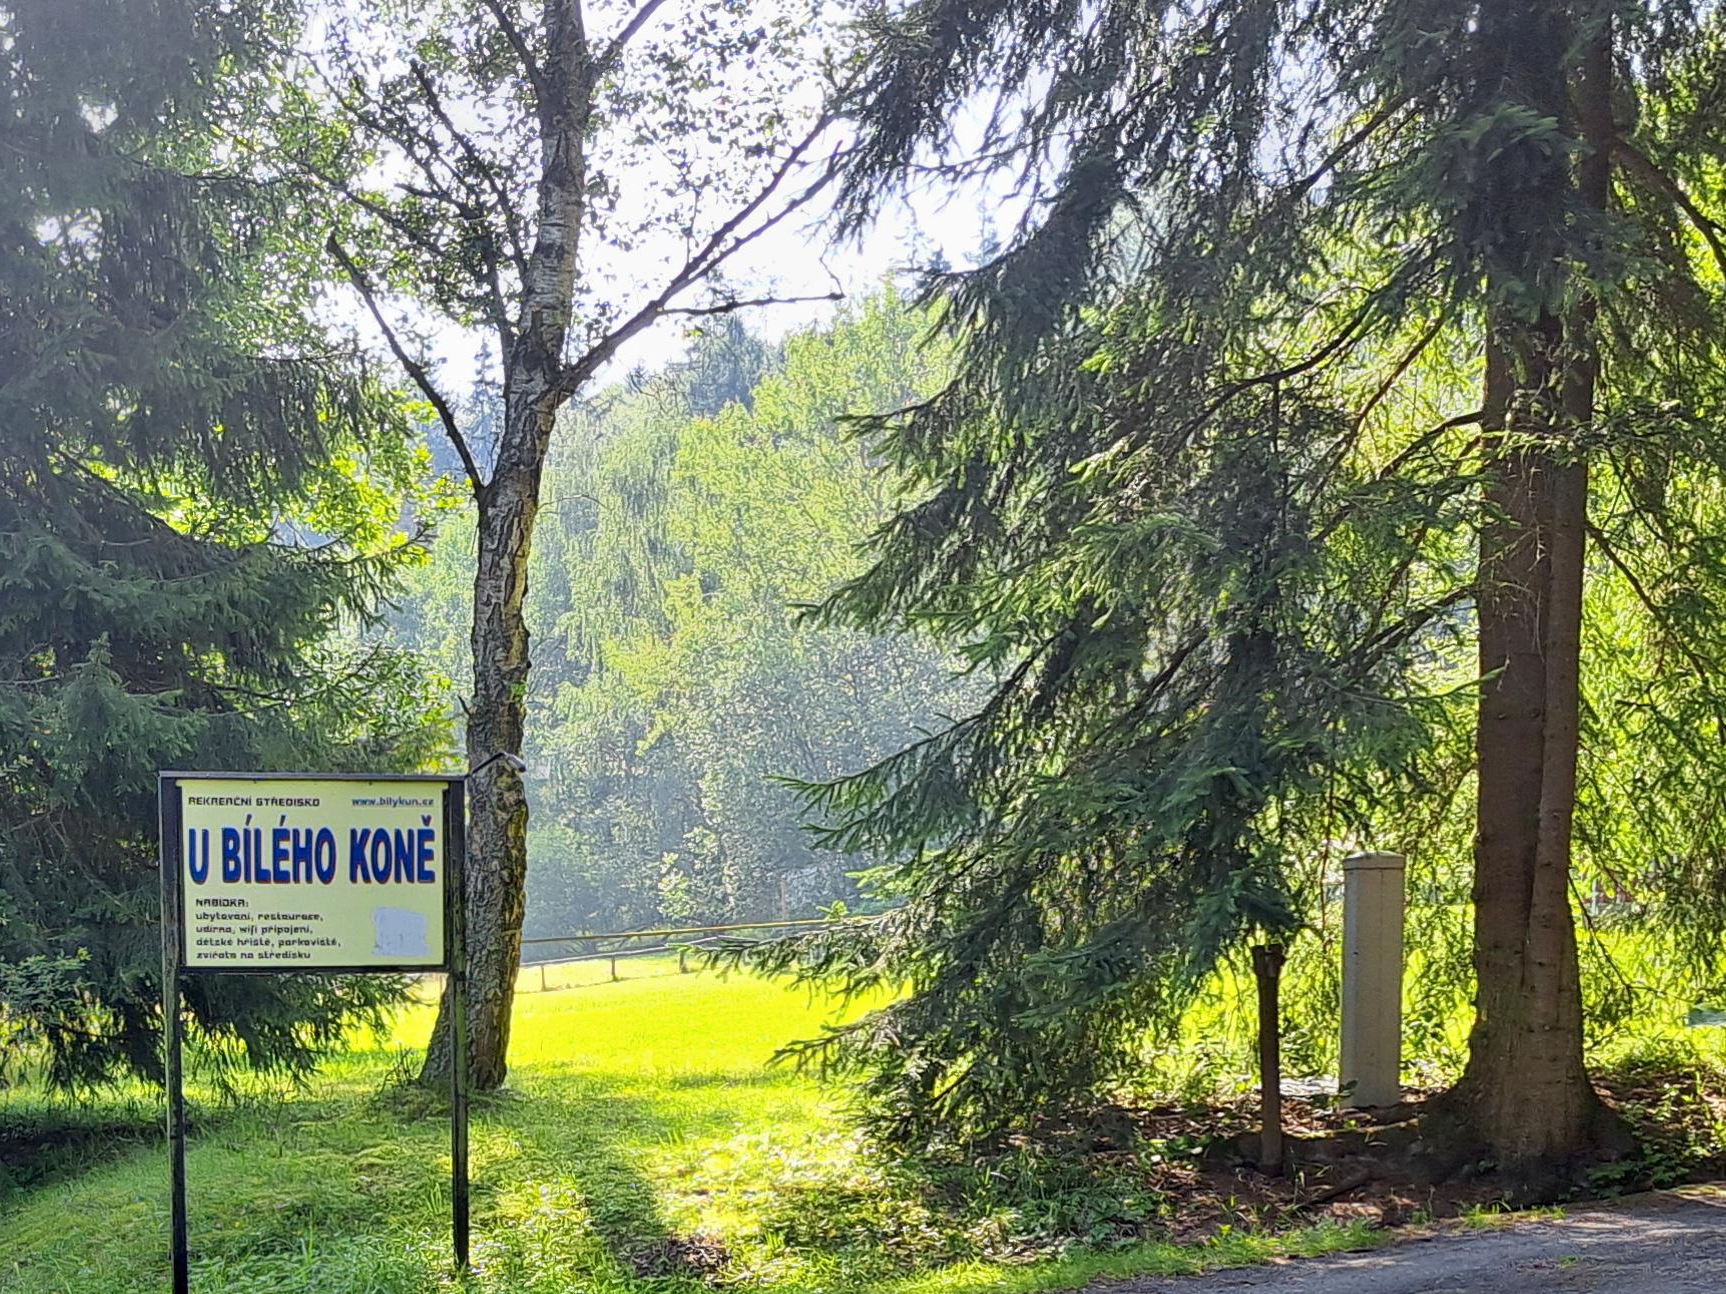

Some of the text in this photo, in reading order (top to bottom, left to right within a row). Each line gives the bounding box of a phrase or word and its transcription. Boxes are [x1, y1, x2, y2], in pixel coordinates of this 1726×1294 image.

[187, 795, 321, 807] REKREAČNÍ STŘEDISKO
[351, 796, 435, 808] www.bilykun.cz
[188, 813, 437, 885] U BÍLÉHO KONĚ
[257, 912, 324, 922] restaurace,
[239, 924, 258, 936] wifi
[240, 951, 255, 960] na
